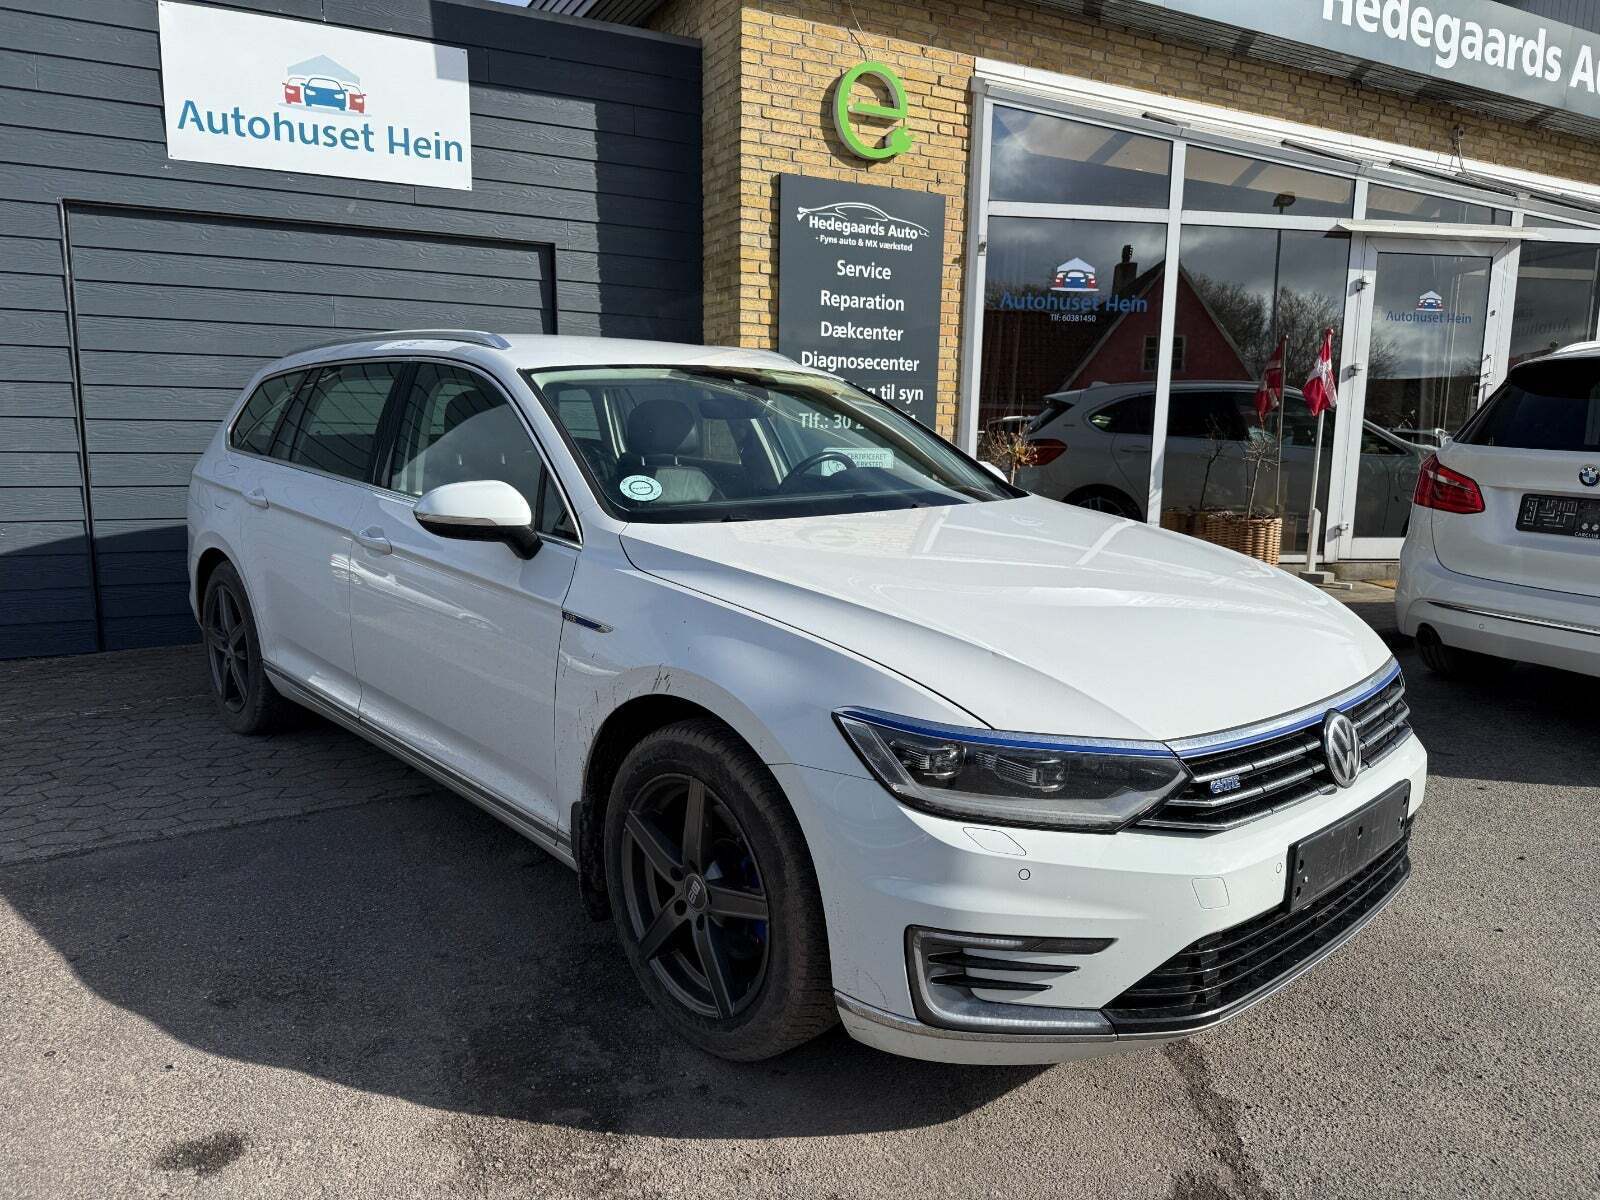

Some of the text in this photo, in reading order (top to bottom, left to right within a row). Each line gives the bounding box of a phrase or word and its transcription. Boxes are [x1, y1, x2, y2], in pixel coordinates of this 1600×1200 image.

[1568, 45, 1600, 94] A
[177, 99, 463, 163] Autohuset Hein
[808, 215, 919, 240] Hedegaards Auto
[819, 234, 838, 245] Fyns
[838, 236, 857, 246] auto
[857, 238, 864, 247] &
[865, 239, 878, 249] MX
[879, 241, 913, 252] værksted
[836, 259, 892, 280] Service
[820, 289, 905, 311] Reparation
[1000, 291, 1148, 313] Autohuset Hein
[1385, 310, 1472, 324] Autohuset Hein
[820, 321, 904, 341] Dækcenter
[801, 351, 920, 372] Diagnosecenter
[880, 383, 896, 400] til
[899, 387, 924, 405] syn
[798, 412, 829, 429] Tlf.:
[833, 413, 852, 430] 30
[849, 453, 888, 461] ERTIFICERET
